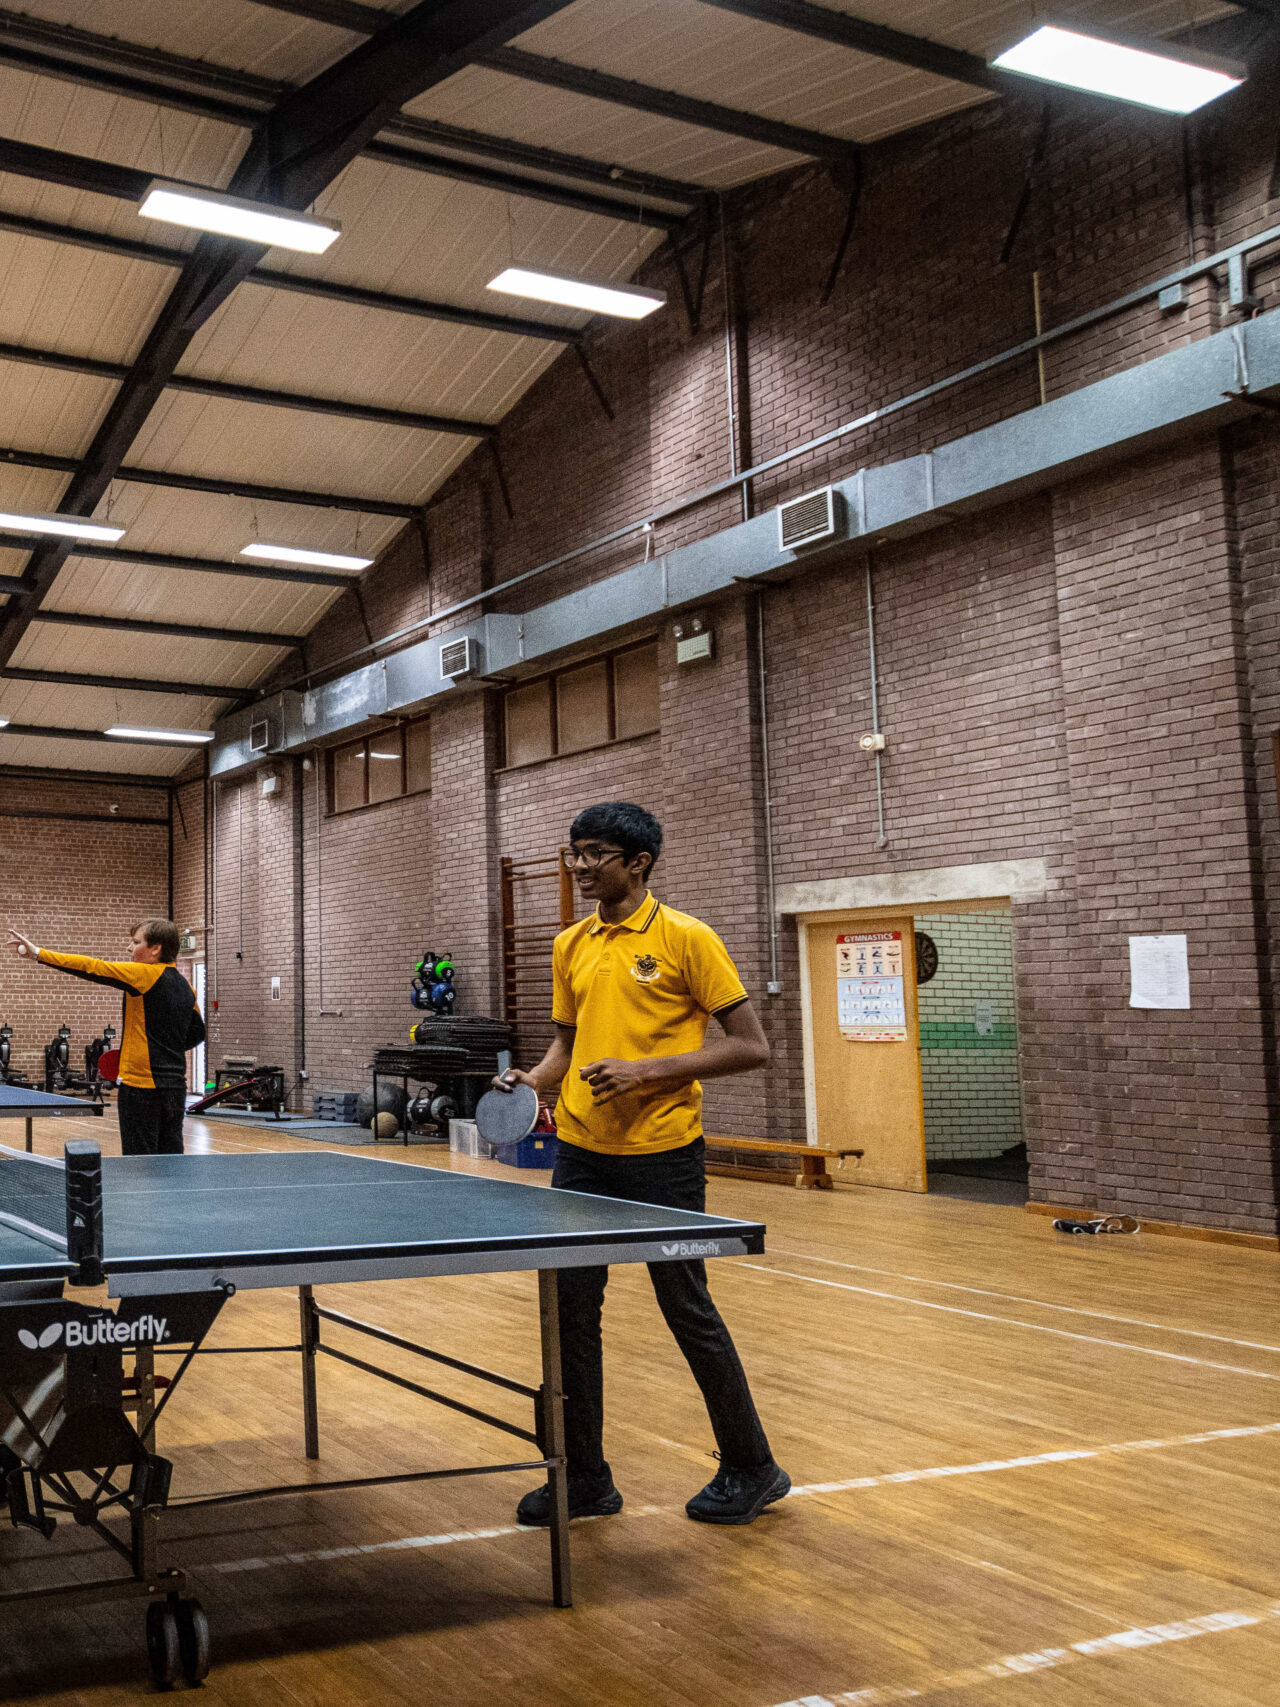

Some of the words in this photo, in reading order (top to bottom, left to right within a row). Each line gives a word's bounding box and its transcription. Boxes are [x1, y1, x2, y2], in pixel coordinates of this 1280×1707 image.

[844, 933, 893, 943] GYMNASTICS
[445, 992, 454, 1001] 10
[680, 1241, 720, 1256] Butterfly
[65, 1314, 168, 1347] Butterfly
